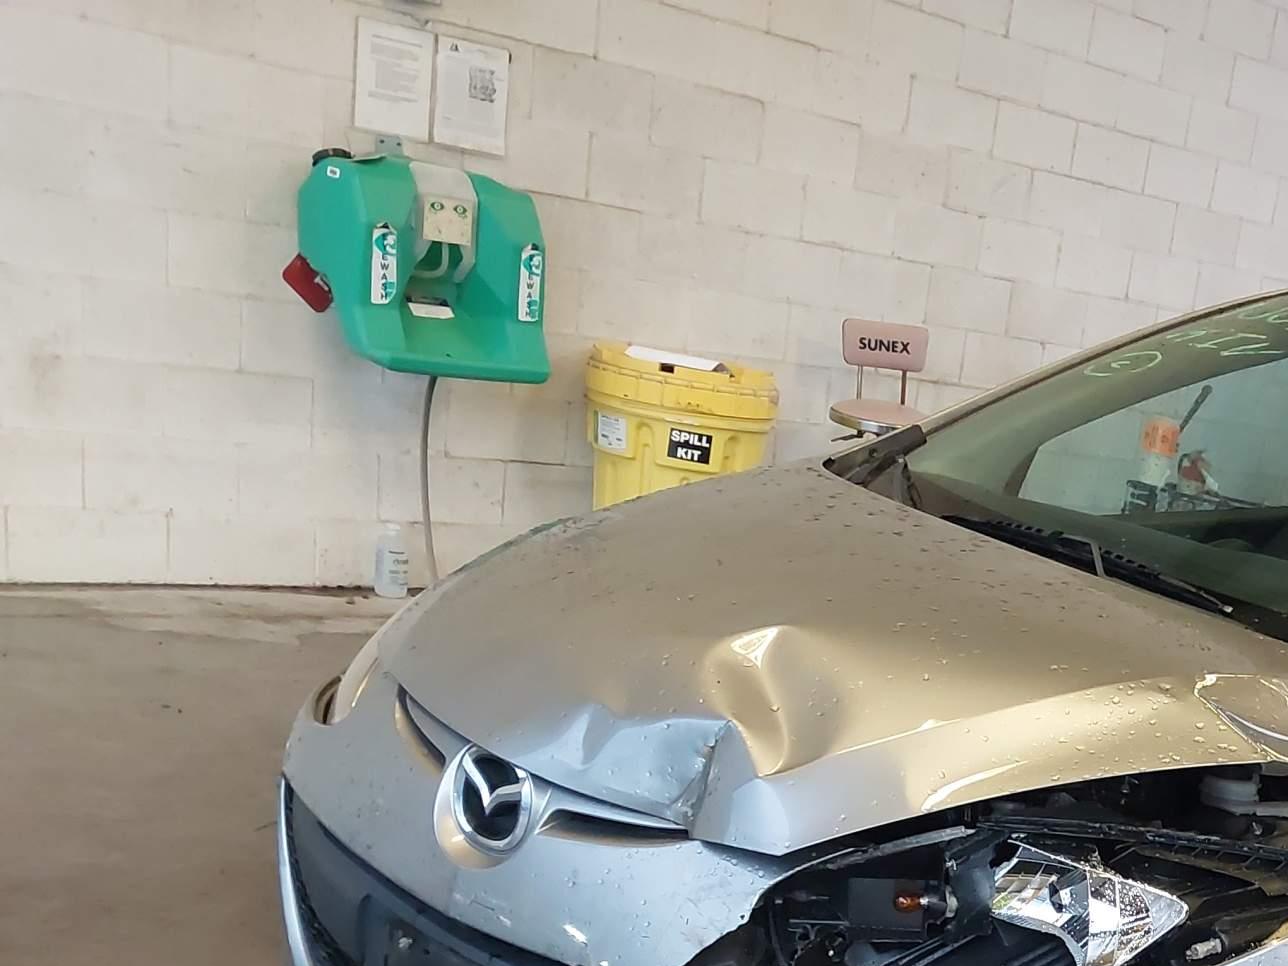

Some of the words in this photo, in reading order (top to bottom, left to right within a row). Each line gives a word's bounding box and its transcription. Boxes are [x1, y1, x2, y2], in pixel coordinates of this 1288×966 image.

[859, 337, 911, 355] SUNEX
[670, 430, 710, 448] SPILL
[676, 447, 702, 461] KIT
